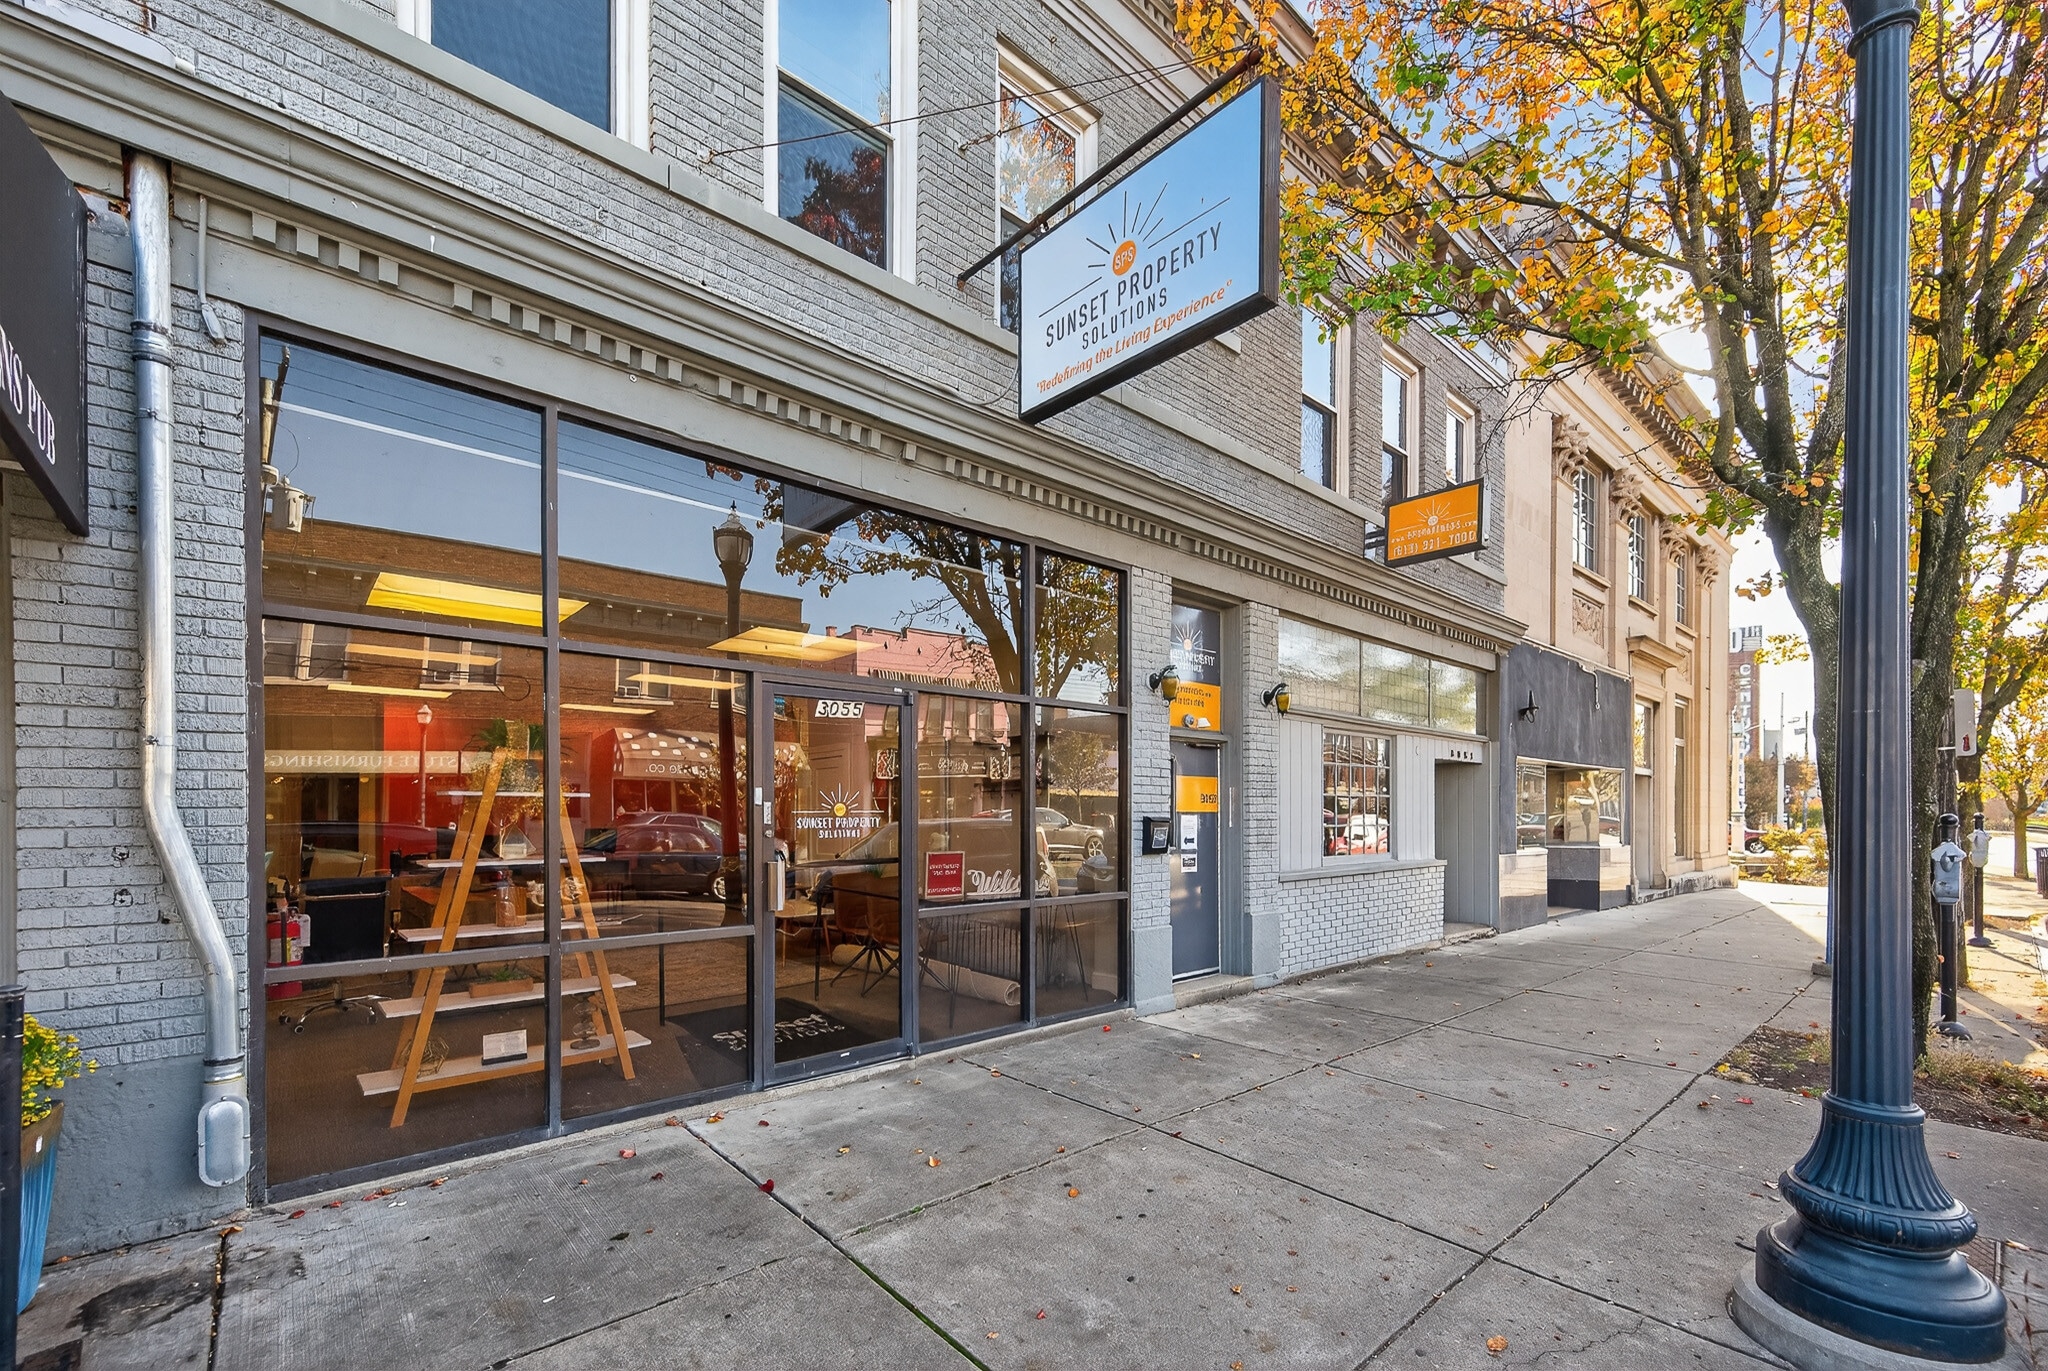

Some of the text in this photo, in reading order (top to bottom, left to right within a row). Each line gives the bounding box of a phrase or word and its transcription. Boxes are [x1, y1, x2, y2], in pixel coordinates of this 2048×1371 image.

[1114, 248, 1135, 271] SPS
[1046, 221, 1222, 348] SUNSET PROPERTY
[1082, 287, 1168, 350] SOLUTIONS
[1095, 344, 1114, 365] the
[1115, 324, 1151, 355] Living
[26, 373, 56, 465] PUB
[818, 701, 863, 717] 3055
[796, 816, 881, 829] SUNSET PROPERTY
